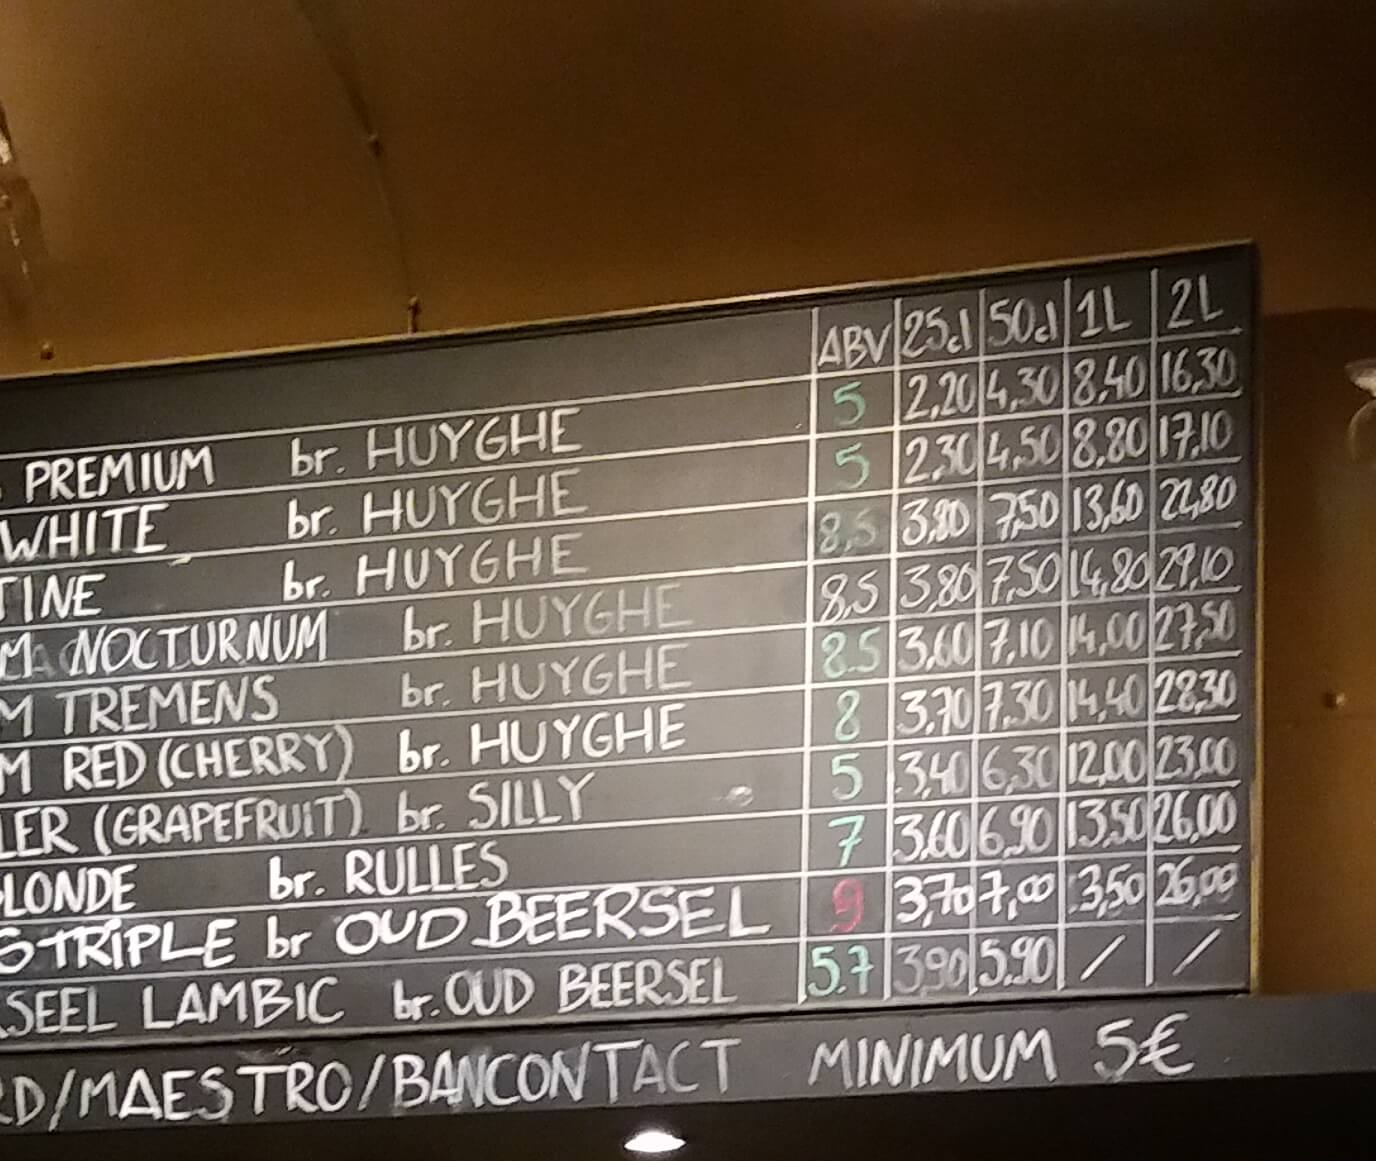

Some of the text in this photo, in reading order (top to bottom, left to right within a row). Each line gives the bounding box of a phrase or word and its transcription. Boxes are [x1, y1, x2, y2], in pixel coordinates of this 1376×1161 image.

[818, 274, 1224, 369] ABV 25cl 50cl 1L 2L
[26, 445, 215, 504] PREMIUM
[291, 438, 346, 477] br.
[367, 407, 583, 471] HUYGHE
[833, 381, 865, 425] 5
[903, 371, 974, 421] 2,20
[987, 365, 1059, 412] 4,30
[1074, 356, 1145, 407] 8,40
[1162, 347, 1237, 395] 16,30
[287, 499, 338, 540] br.
[363, 467, 588, 535] HUYGHE
[835, 443, 869, 488] 5
[904, 432, 977, 484] 2,30
[987, 424, 1060, 470] 4,50
[1073, 418, 1147, 469] 8,80
[1159, 409, 1232, 460] 17,10
[283, 561, 331, 601] br.
[356, 533, 588, 596] HUYGHE
[989, 489, 1059, 541] 7,50
[1073, 478, 1144, 533] 13,60
[70, 609, 327, 676] NOCTURNUM
[404, 606, 453, 652] br.
[471, 583, 693, 645] HUYGHE
[821, 570, 878, 623] 8,5
[900, 562, 976, 613] 3,80
[987, 550, 1060, 605] 7,50
[1070, 547, 1150, 598] 14,80
[1155, 543, 1234, 592] 29,10
[58, 676, 281, 736] TREMENS
[401, 672, 451, 709] br.
[471, 643, 693, 704] HUYGHE
[897, 621, 974, 672] 3,60
[983, 617, 1054, 665] 7,10
[1069, 611, 1146, 657] 14,00
[63, 742, 146, 792] RED
[159, 723, 353, 789] (CHERRY)
[398, 730, 451, 776] br.
[470, 702, 687, 766] HUYGHE
[835, 690, 860, 741] 8
[897, 686, 972, 735] 3,70
[982, 679, 1055, 731] 7,30
[1068, 674, 1143, 722] 14,40
[94, 787, 364, 856] (GRAPEFRUIT)
[397, 792, 446, 835] br.
[468, 771, 596, 831] SILLY
[832, 753, 863, 800] 5
[895, 751, 969, 799] 3,40
[982, 745, 1057, 795] 6,30
[1069, 739, 1146, 787] 12,00
[1155, 735, 1236, 780] 23,00
[269, 855, 325, 900] br.
[345, 840, 509, 896] RULLES
[828, 815, 865, 867] 7
[893, 810, 970, 863] 3,60
[980, 803, 1054, 858] 6,90
[1068, 797, 1147, 849] 13,50
[1153, 790, 1237, 843] 26,00
[267, 916, 312, 959] br
[335, 908, 468, 956] OUD
[472, 885, 771, 950] BEERSEL
[830, 878, 864, 933] 9
[894, 872, 975, 928] 3,70
[979, 870, 1056, 920] 7,00
[1155, 856, 1239, 909] 26,00
[143, 976, 345, 1031] LAMBIC
[559, 957, 738, 1013] BEERSEL
[808, 1027, 1057, 1089] MINIMUM
[1093, 1012, 1194, 1081] 5€
